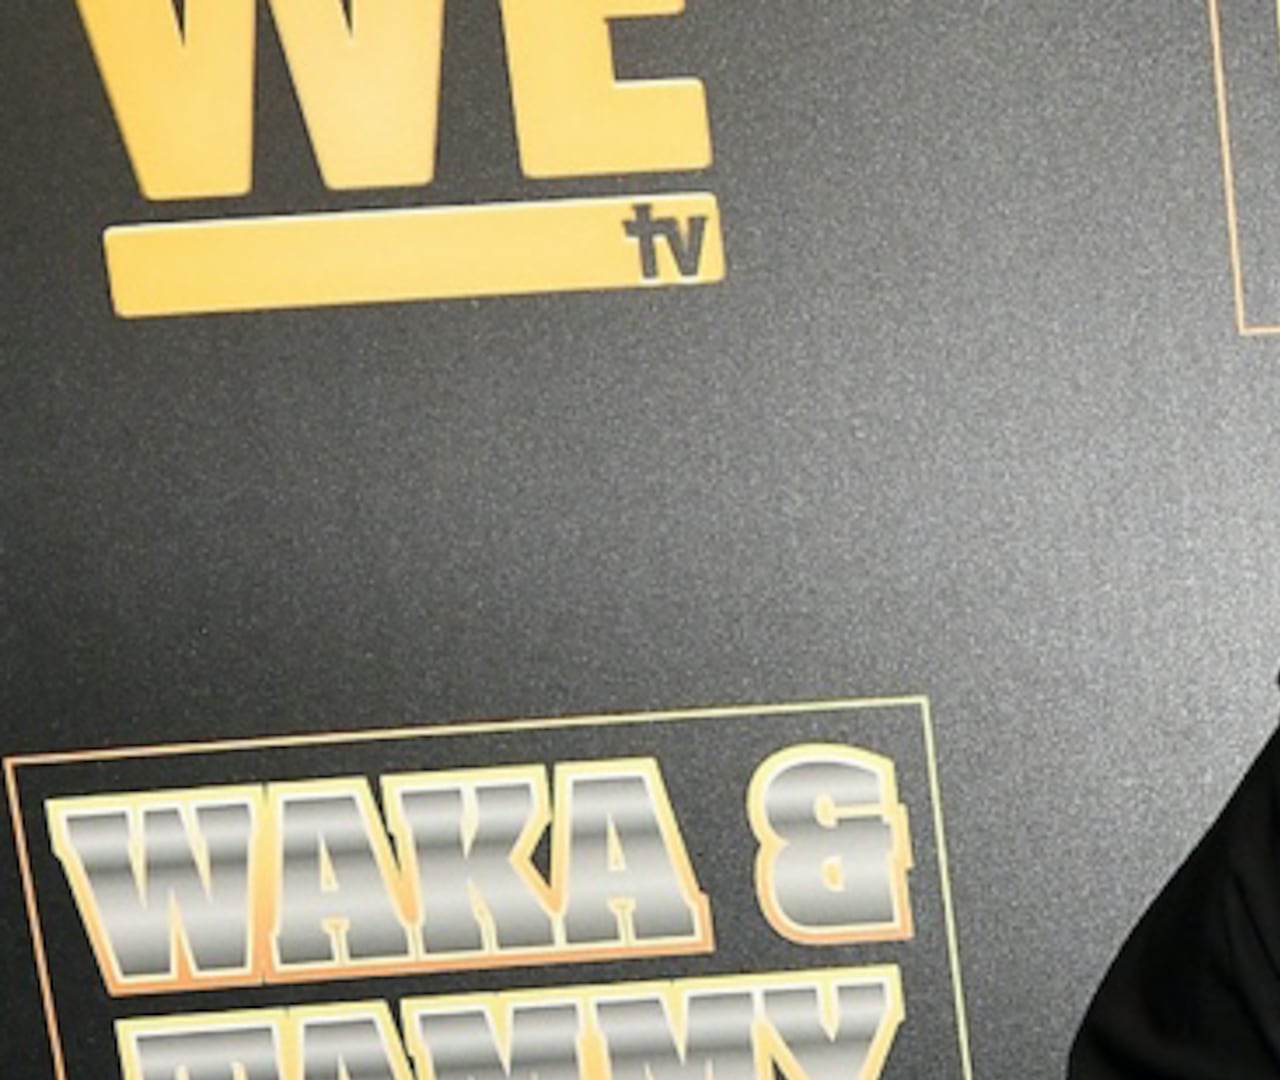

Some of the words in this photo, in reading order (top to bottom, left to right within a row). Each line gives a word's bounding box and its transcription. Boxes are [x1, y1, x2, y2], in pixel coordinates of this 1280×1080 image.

[622, 203, 707, 280] tv
[46, 757, 714, 997] WAKA
[749, 743, 914, 943] &
